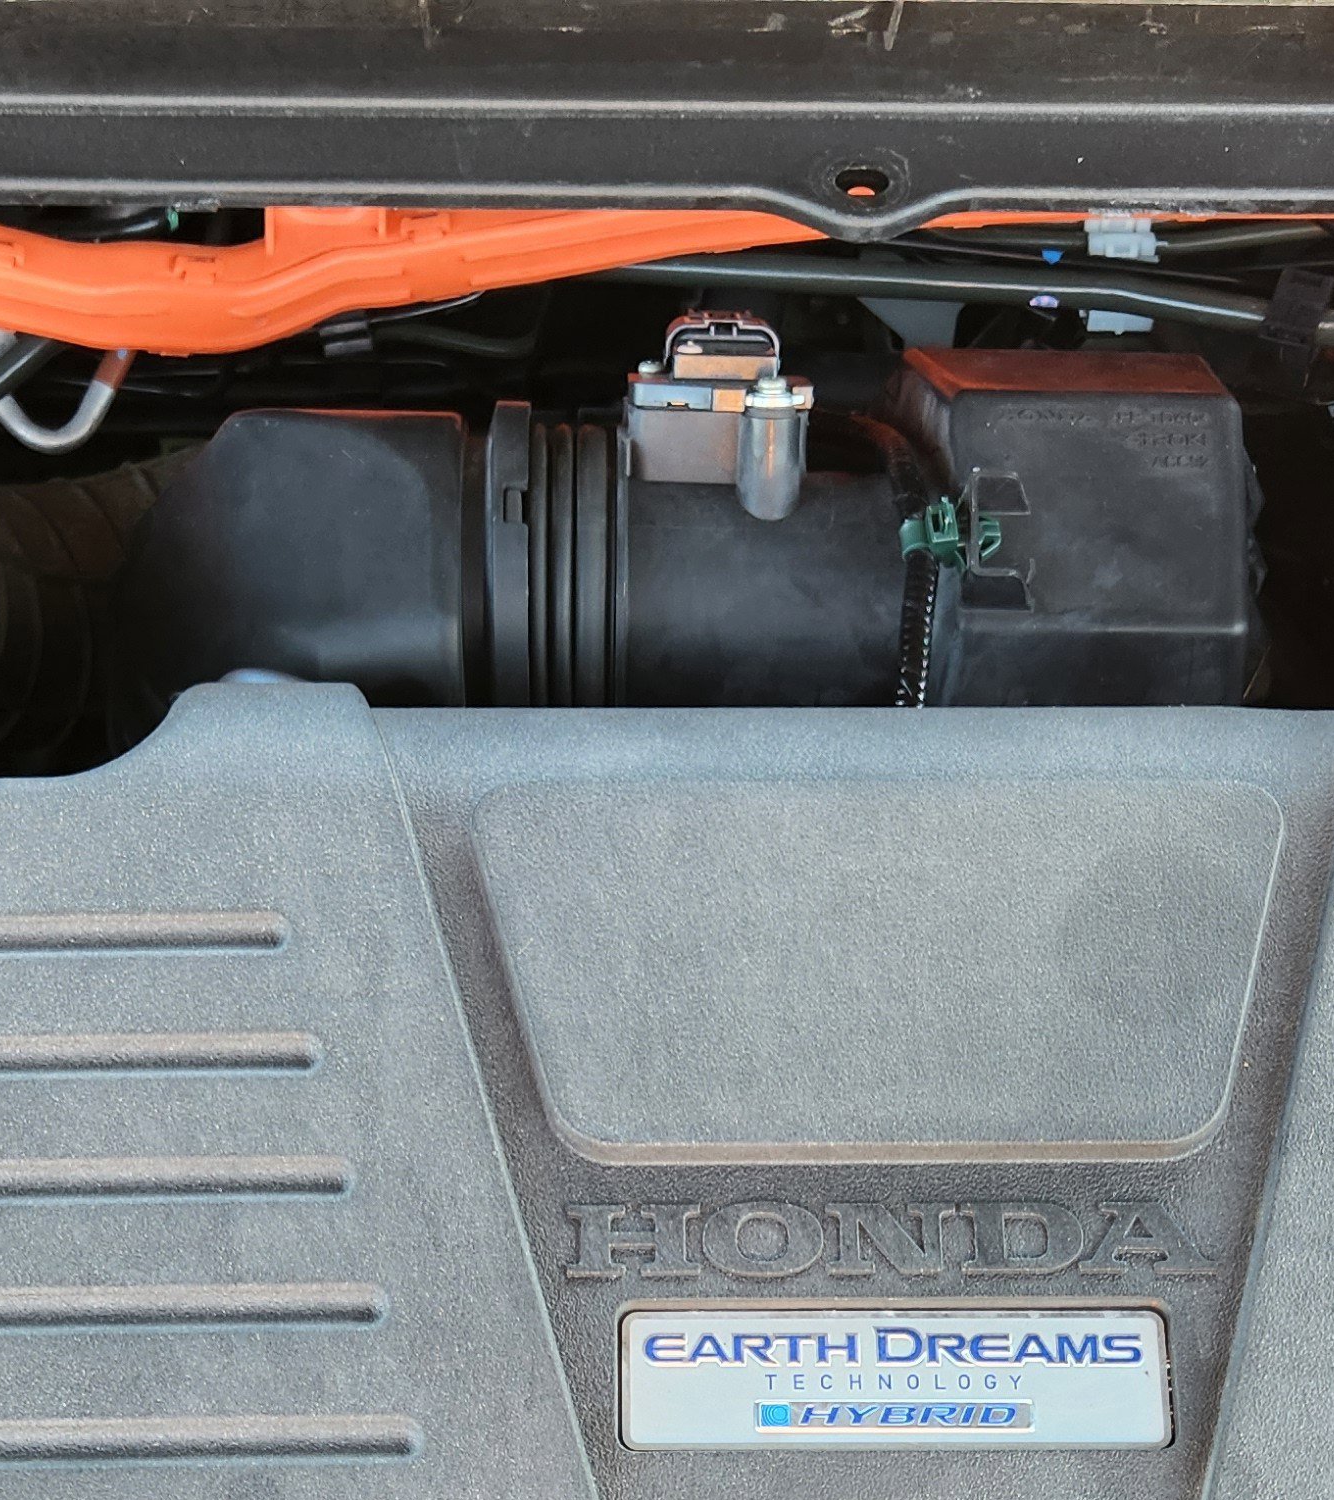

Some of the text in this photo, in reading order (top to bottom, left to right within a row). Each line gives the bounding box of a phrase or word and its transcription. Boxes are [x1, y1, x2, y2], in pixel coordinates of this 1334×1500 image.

[566, 1199, 1220, 1278] HONDA
[643, 1325, 1145, 1367] EARTH DREAMS
[764, 1373, 1024, 1391] TECHNOLOGY
[798, 1402, 1018, 1427] HYBRID
